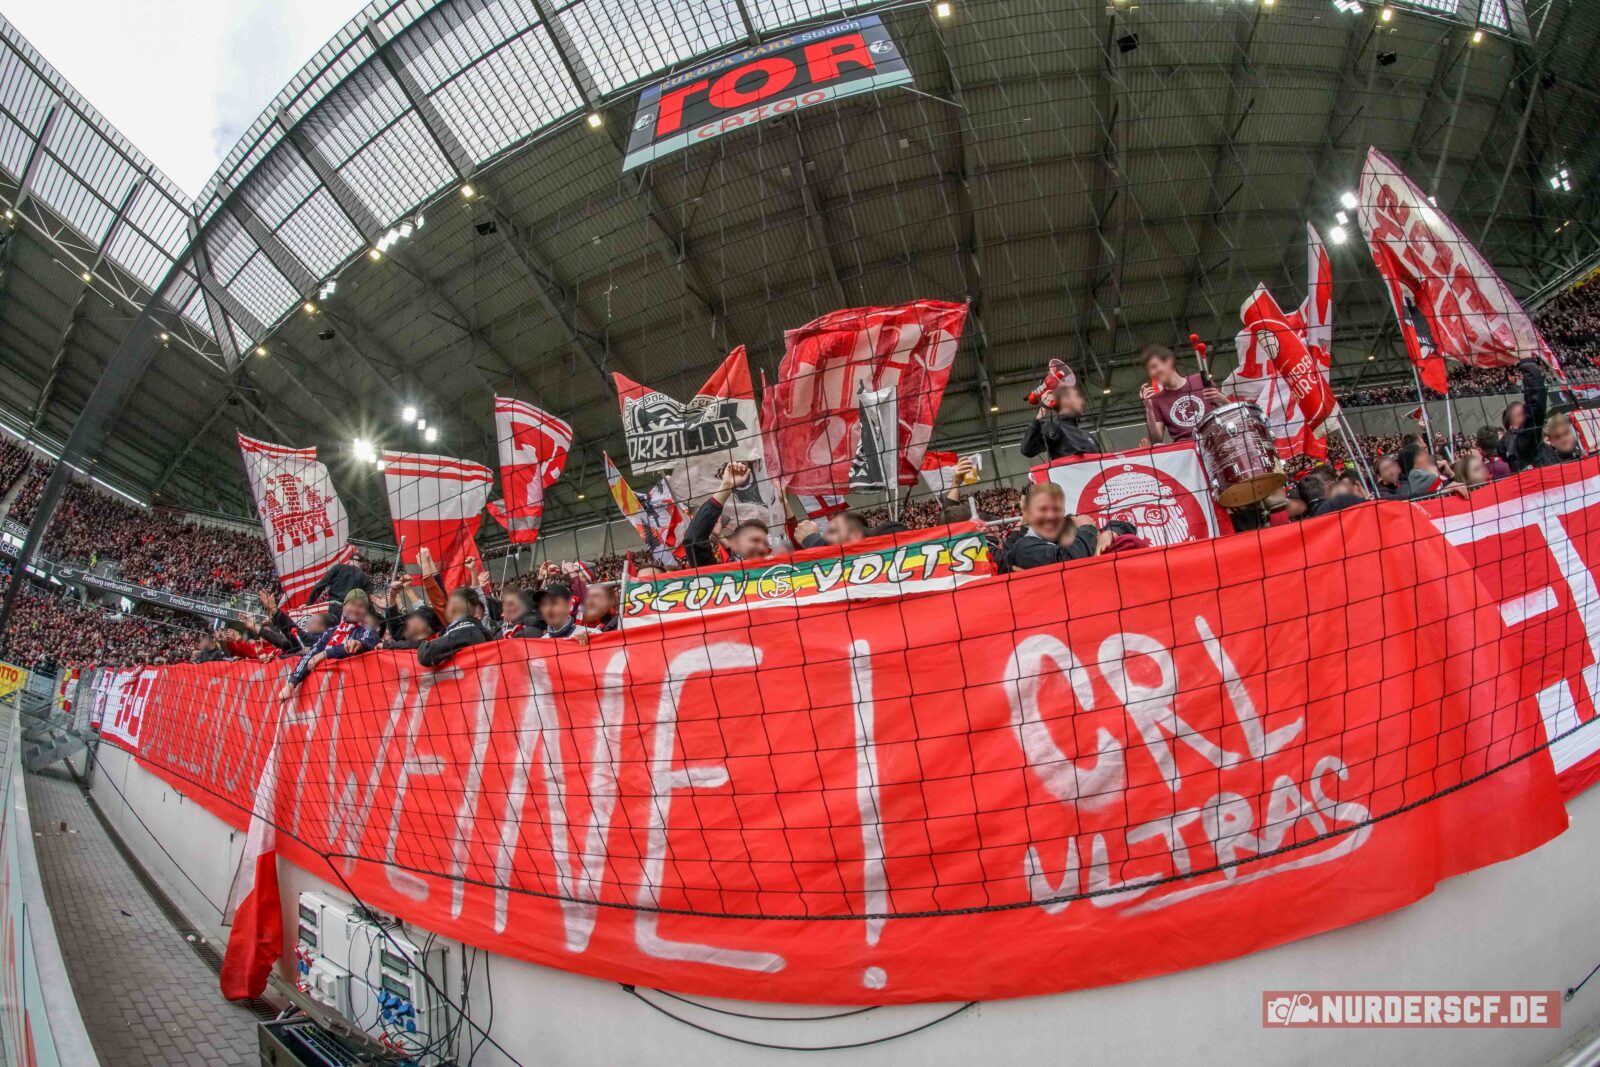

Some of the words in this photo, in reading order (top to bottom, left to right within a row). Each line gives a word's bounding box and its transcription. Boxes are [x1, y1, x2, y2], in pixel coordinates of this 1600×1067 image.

[655, 33, 876, 137] TOR
[659, 57, 735, 91] EUROPA
[742, 36, 796, 60] PARK
[801, 19, 860, 42] Stadion
[696, 90, 827, 140] CAZOO
[0, 541, 18, 559] GER
[82, 574, 104, 588] Freiburg
[1004, 614, 1305, 814] CRL
[1023, 755, 1373, 917] ULTRAS
